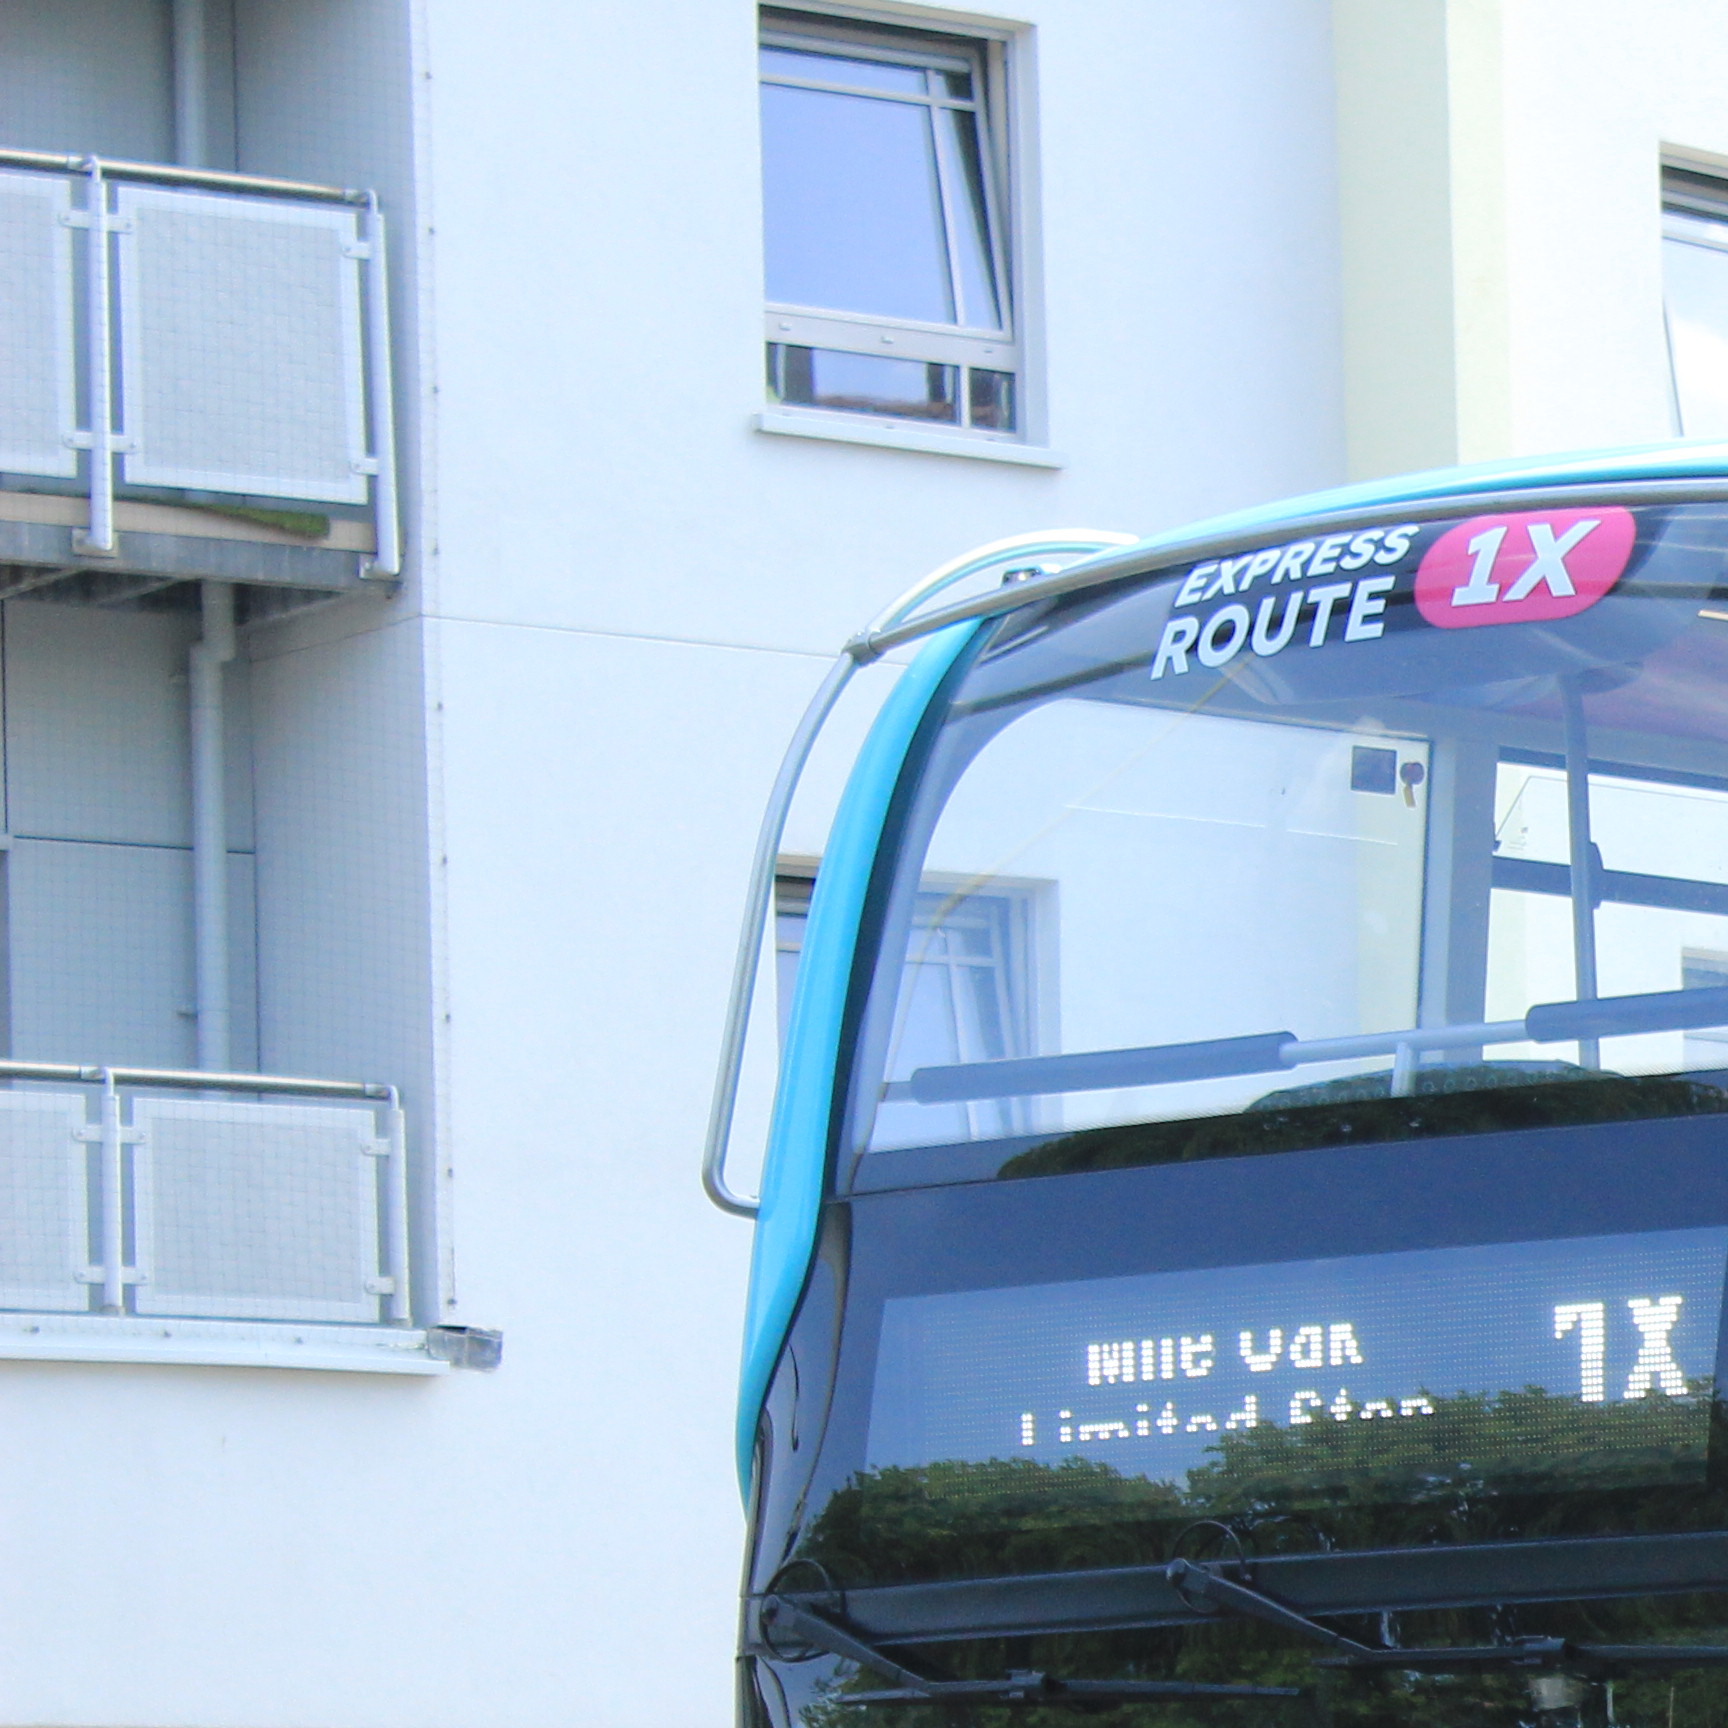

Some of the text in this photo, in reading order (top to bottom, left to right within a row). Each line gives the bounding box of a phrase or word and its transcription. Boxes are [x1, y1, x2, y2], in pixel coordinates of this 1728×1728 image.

[1174, 525, 1420, 607] EXPRESS
[1450, 519, 1602, 607] 1X
[1150, 575, 1396, 680] ROUTE
[1554, 1296, 1688, 1403] 1X
